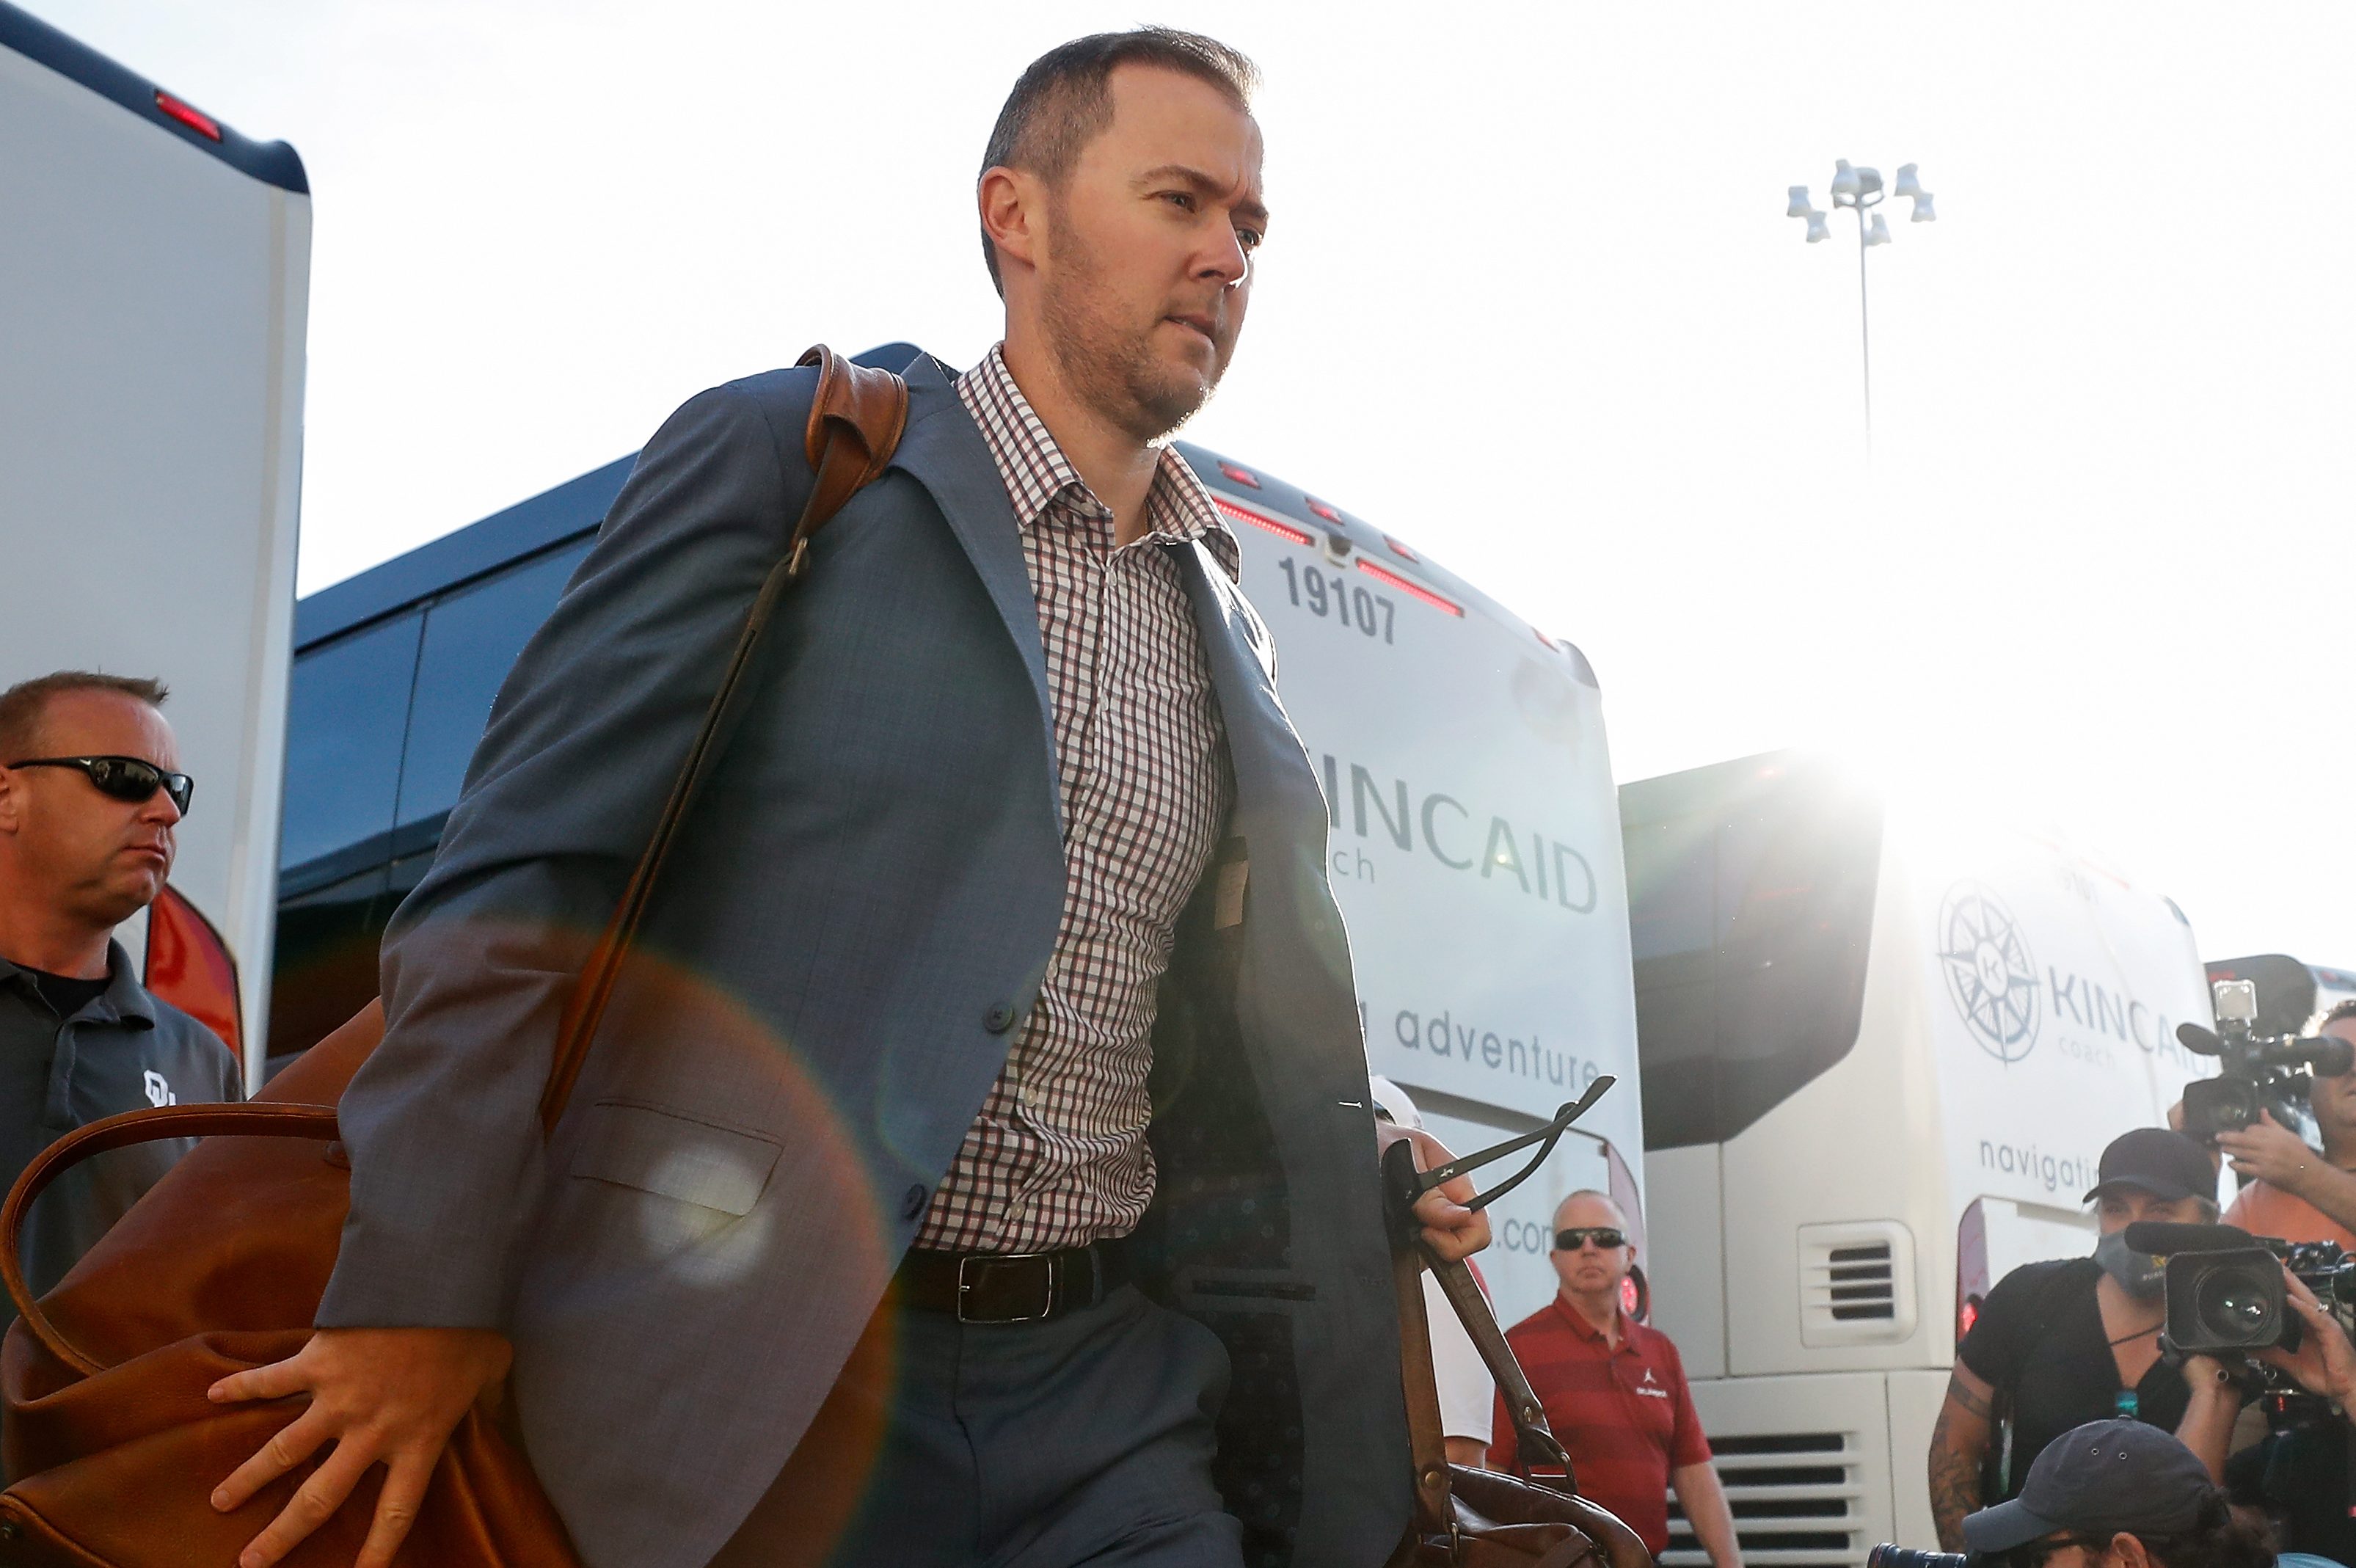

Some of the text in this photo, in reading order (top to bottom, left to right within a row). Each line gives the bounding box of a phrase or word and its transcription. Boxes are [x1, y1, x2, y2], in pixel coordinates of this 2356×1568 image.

[1278, 555, 1395, 645] 19107
[1323, 754, 1598, 916] INCAID
[1983, 956, 2002, 982] K
[1395, 1009, 1600, 1090] adventure
[2058, 1035, 2115, 1069] coach
